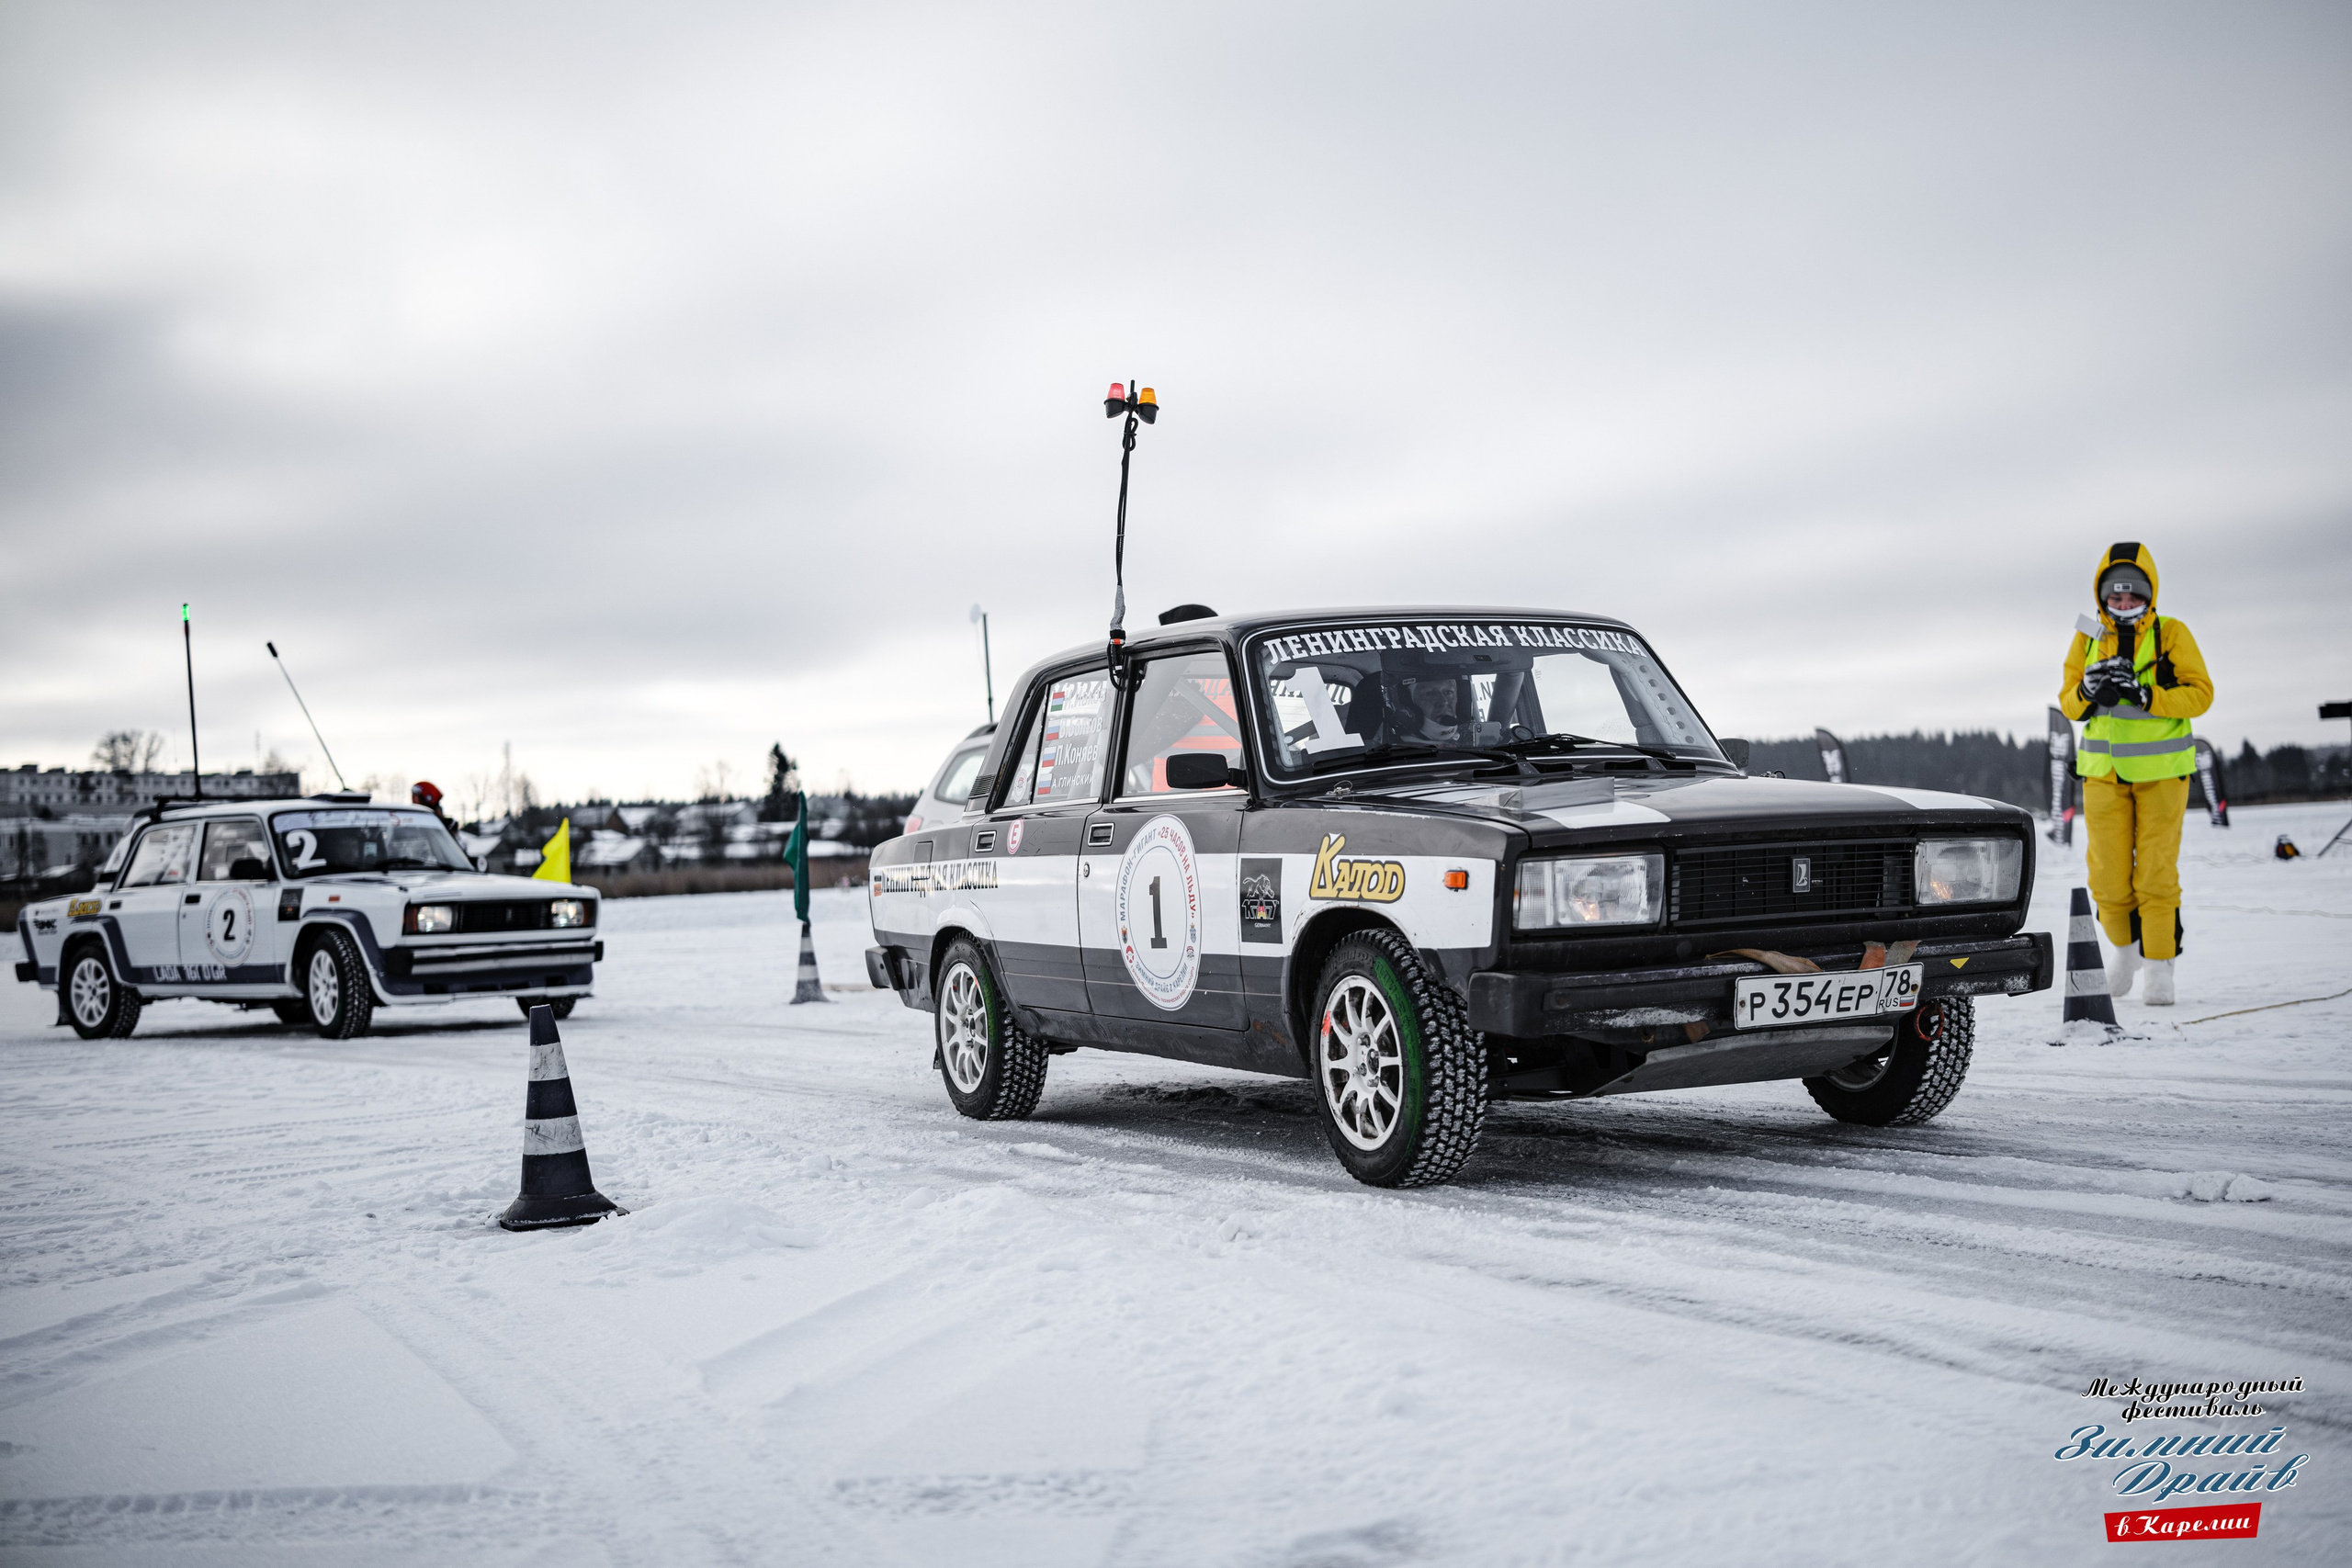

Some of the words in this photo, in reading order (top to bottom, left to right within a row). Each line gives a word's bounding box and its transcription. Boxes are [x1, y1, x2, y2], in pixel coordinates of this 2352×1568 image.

[1263, 625, 1508, 665] ЛЕНИНГРАДСКАЯ
[1510, 625, 1647, 659] КЛАССИКА
[1284, 666, 1364, 754] 1
[286, 829, 327, 871] 2
[1170, 829, 1186, 857] ЧАСОВ
[1182, 854, 1191, 874] НА
[222, 908, 236, 942] 2
[1148, 875, 1168, 949] 1
[1878, 997, 1899, 1010] RUS
[1884, 969, 1911, 998] 78
